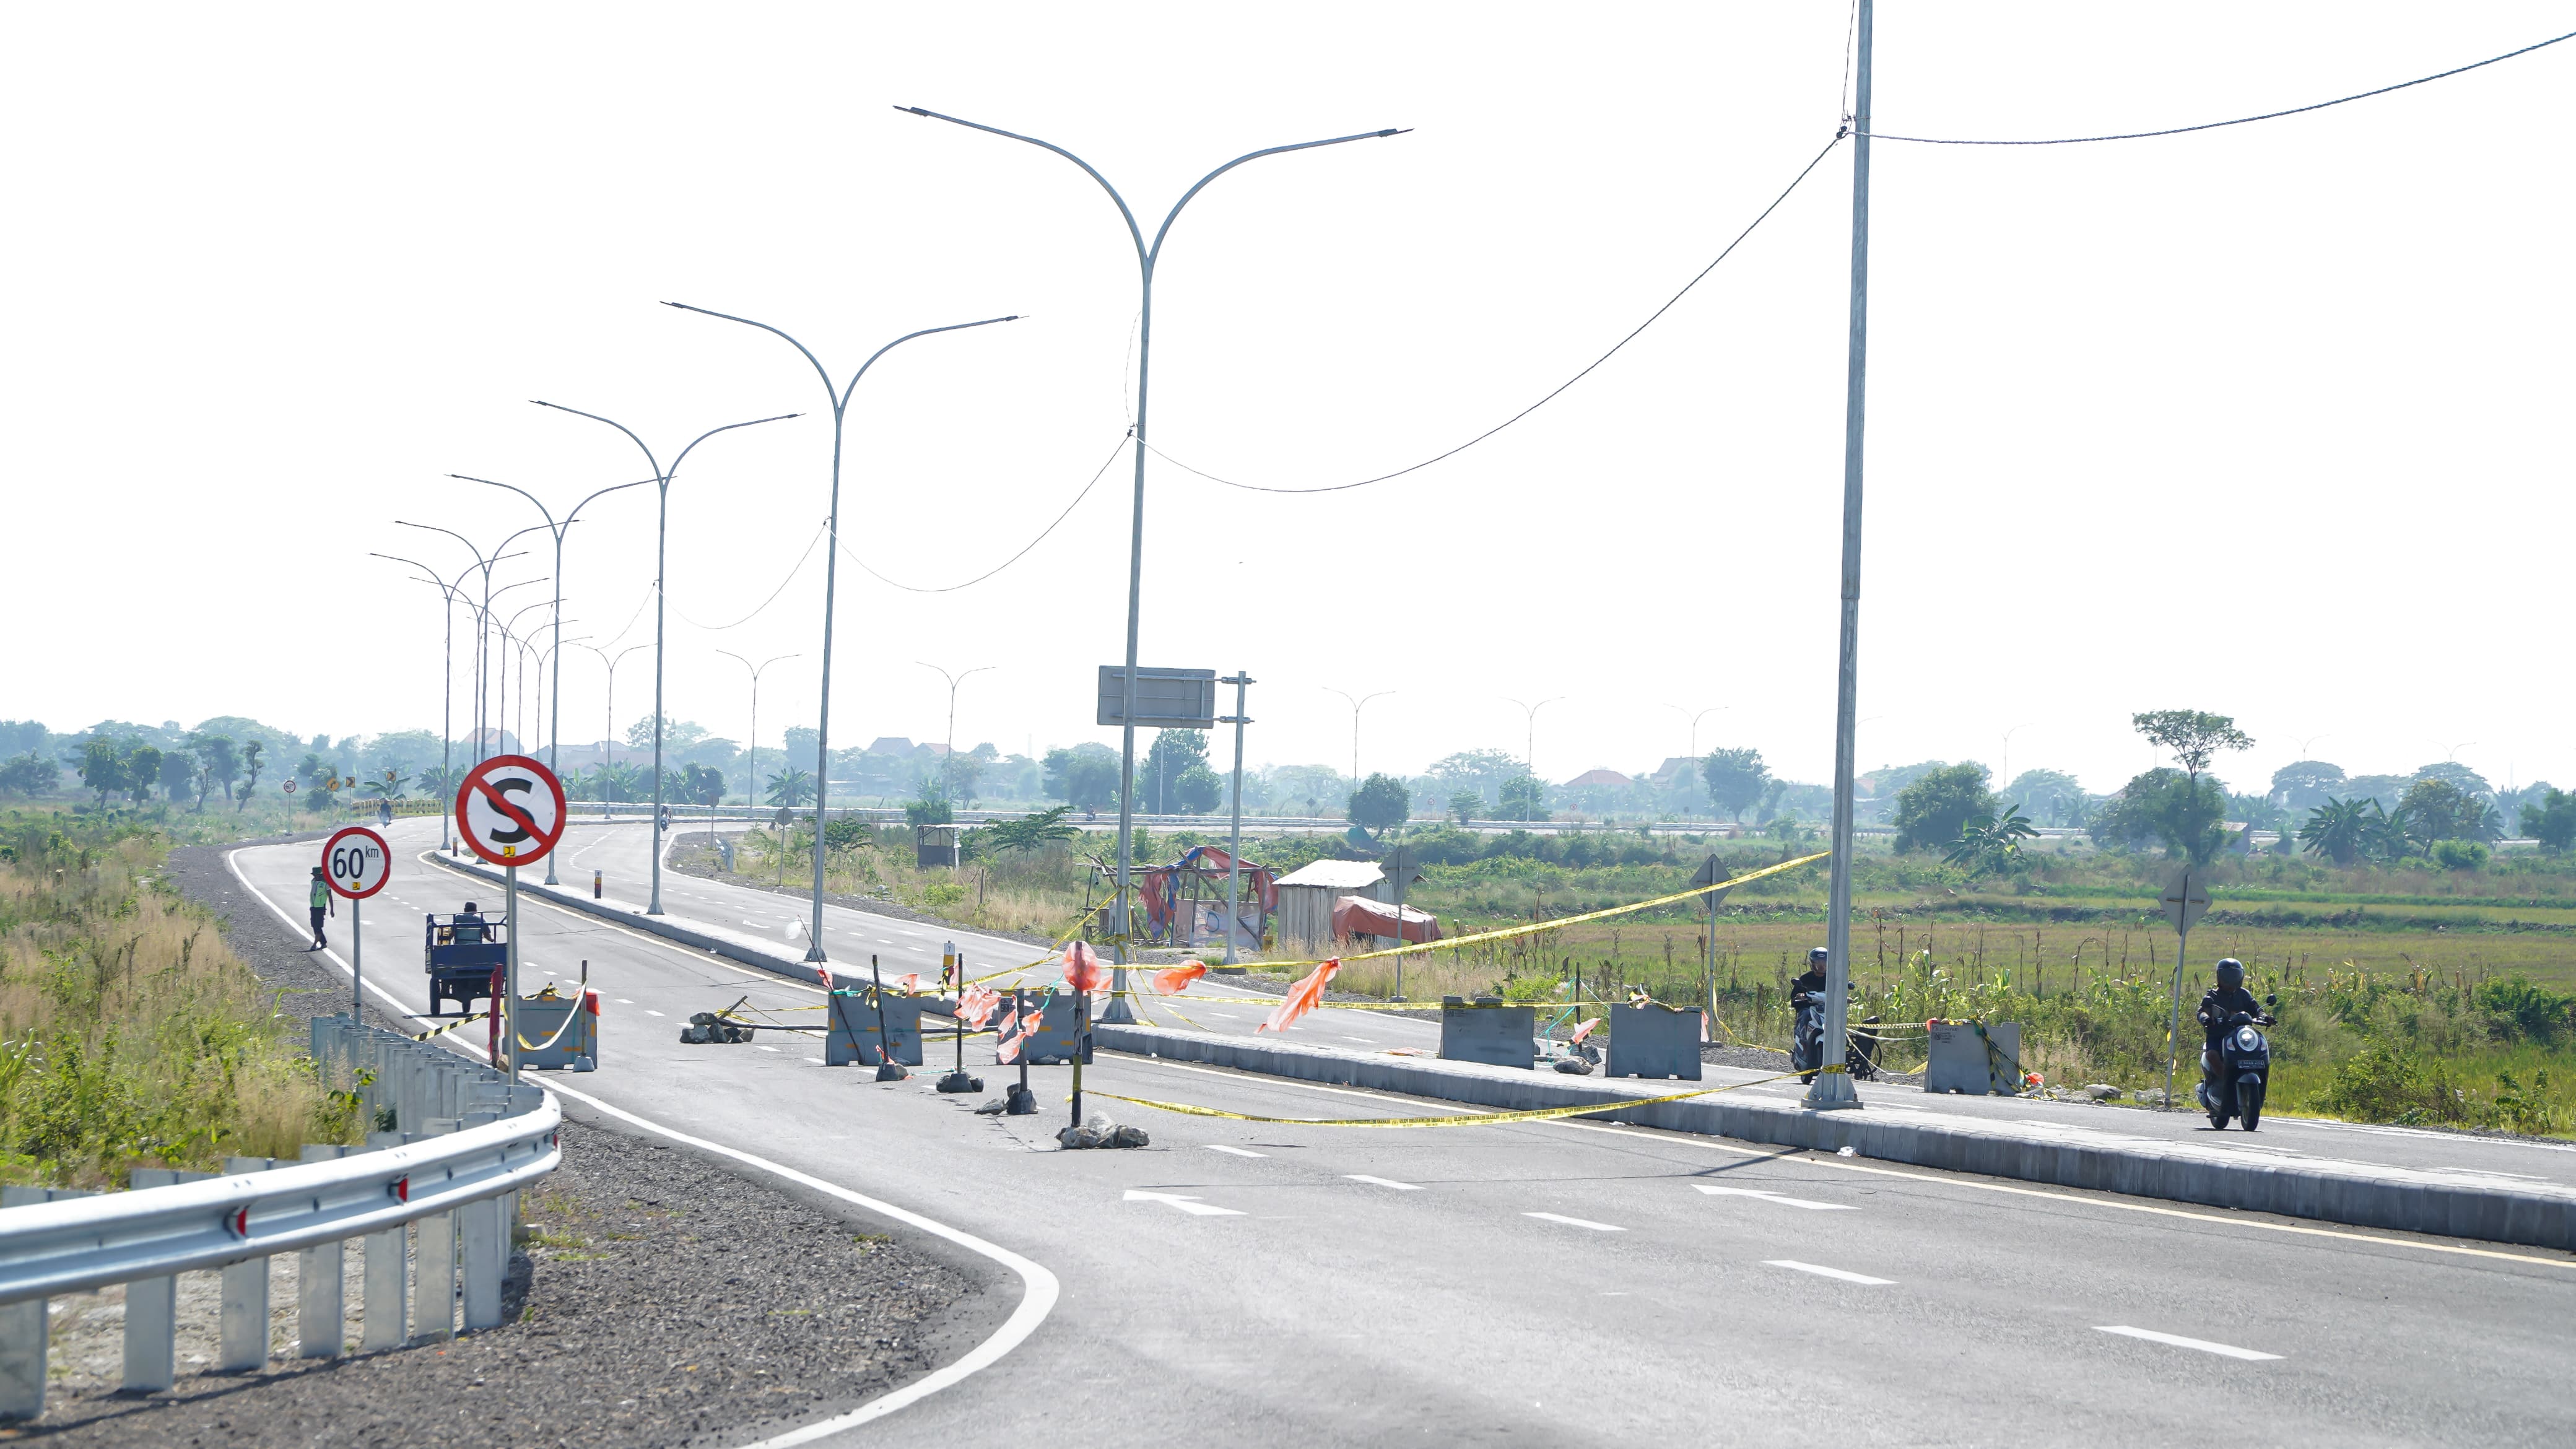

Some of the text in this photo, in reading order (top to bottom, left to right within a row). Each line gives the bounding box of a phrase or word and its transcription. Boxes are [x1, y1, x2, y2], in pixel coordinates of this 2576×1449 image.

[486, 777, 536, 844] S
[333, 845, 379, 879] 60 km
